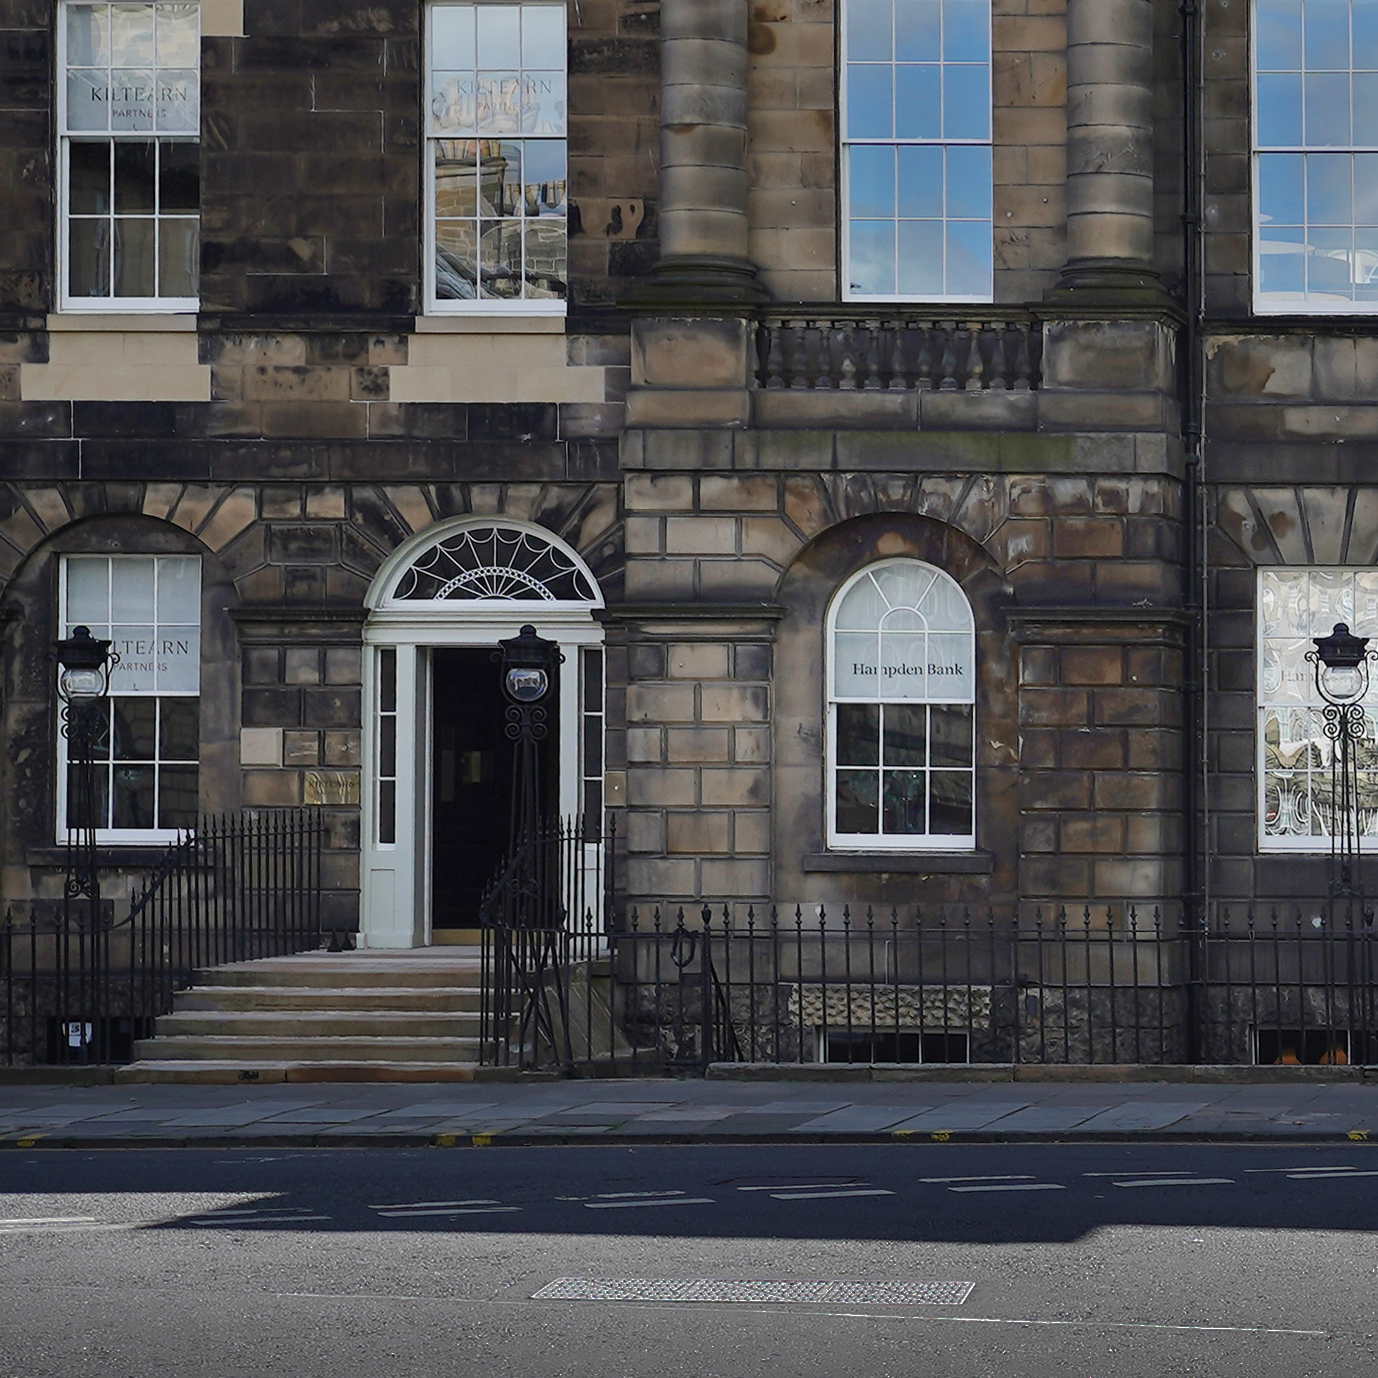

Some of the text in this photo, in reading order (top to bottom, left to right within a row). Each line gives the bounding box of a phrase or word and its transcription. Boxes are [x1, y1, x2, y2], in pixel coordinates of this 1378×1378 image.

[91, 87, 188, 102] KILTEARN
[456, 80, 553, 95] KILTEARN
[112, 108, 167, 118] PARTNERS
[112, 640, 189, 655] LTEARN
[853, 663, 964, 679] Hampden Bank
